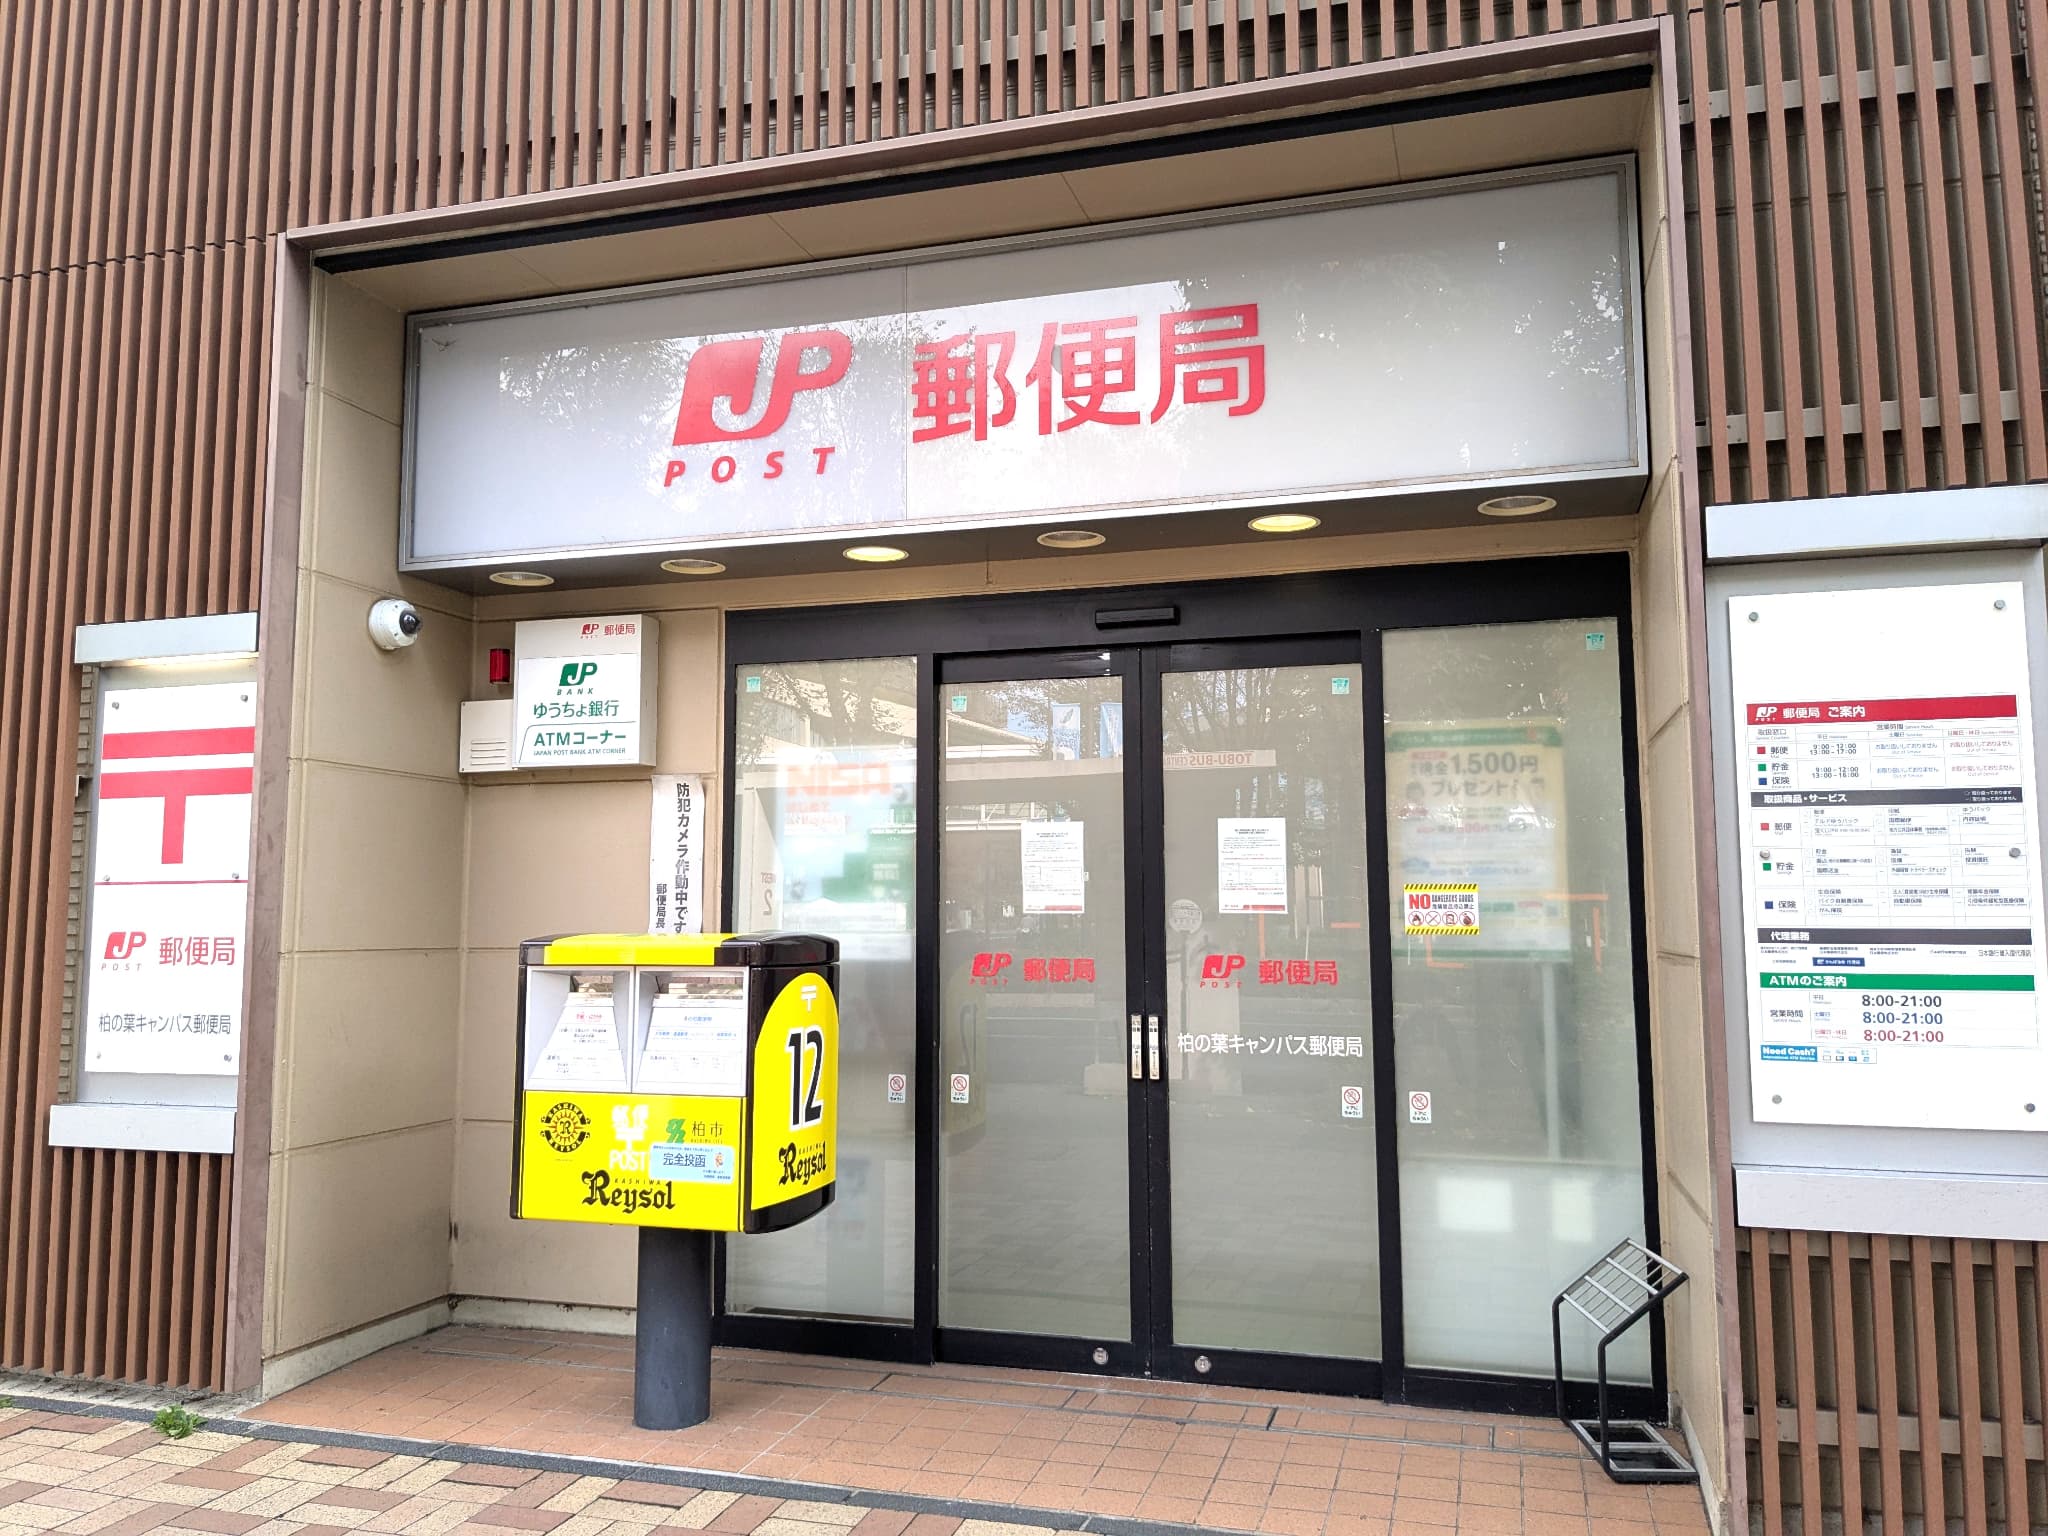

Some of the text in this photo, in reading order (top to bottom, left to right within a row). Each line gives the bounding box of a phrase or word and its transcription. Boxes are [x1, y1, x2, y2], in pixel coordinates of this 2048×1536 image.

[912, 303, 1266, 443] 郵便局
[664, 446, 835, 487] POST
[604, 624, 636, 636] 郵便局
[557, 688, 594, 696] BANK
[533, 700, 619, 719] ゆうちょ銀行
[1782, 707, 1820, 718] 郵便局
[1828, 706, 1866, 718] ご案内
[533, 730, 627, 747] ATMコーナー
[1770, 746, 1789, 755] 郵便
[1771, 763, 1789, 771] 貯金
[1772, 776, 1790, 785] 保険
[1774, 823, 1793, 831] 郵便
[674, 783, 691, 934] 防犯カメラ作動中です
[1776, 862, 1794, 870] 貯金
[655, 883, 667, 929] 郵便局長
[1409, 893, 1431, 910] NO
[1778, 900, 1797, 909] 保険
[159, 936, 236, 966] 郵便局
[101, 963, 142, 972] POST
[1024, 958, 1096, 983] 郵便局
[1258, 960, 1339, 986] 郵便局
[1769, 975, 1847, 988] ATMのご案内
[1861, 994, 1942, 1008] 8:00-21:00
[1770, 1009, 1804, 1018] 営業時間
[1862, 1011, 1943, 1025] 8:00-21:00
[99, 1013, 232, 1035] 柏の葉キャンパス郵便局
[1863, 1029, 1944, 1042] 8:00-21:00
[1177, 1032, 1363, 1057] 柏の葉キャンパス郵便局
[1762, 1046, 1816, 1057] Need Cash?
[786, 1027, 824, 1130] 12
[692, 1120, 725, 1138] 柏市
[609, 1150, 646, 1172] POST
[663, 1152, 707, 1168] 完全投函
[779, 1140, 827, 1186] Reysol
[615, 1177, 662, 1186] KASHIWA
[582, 1169, 676, 1214] Reysol
